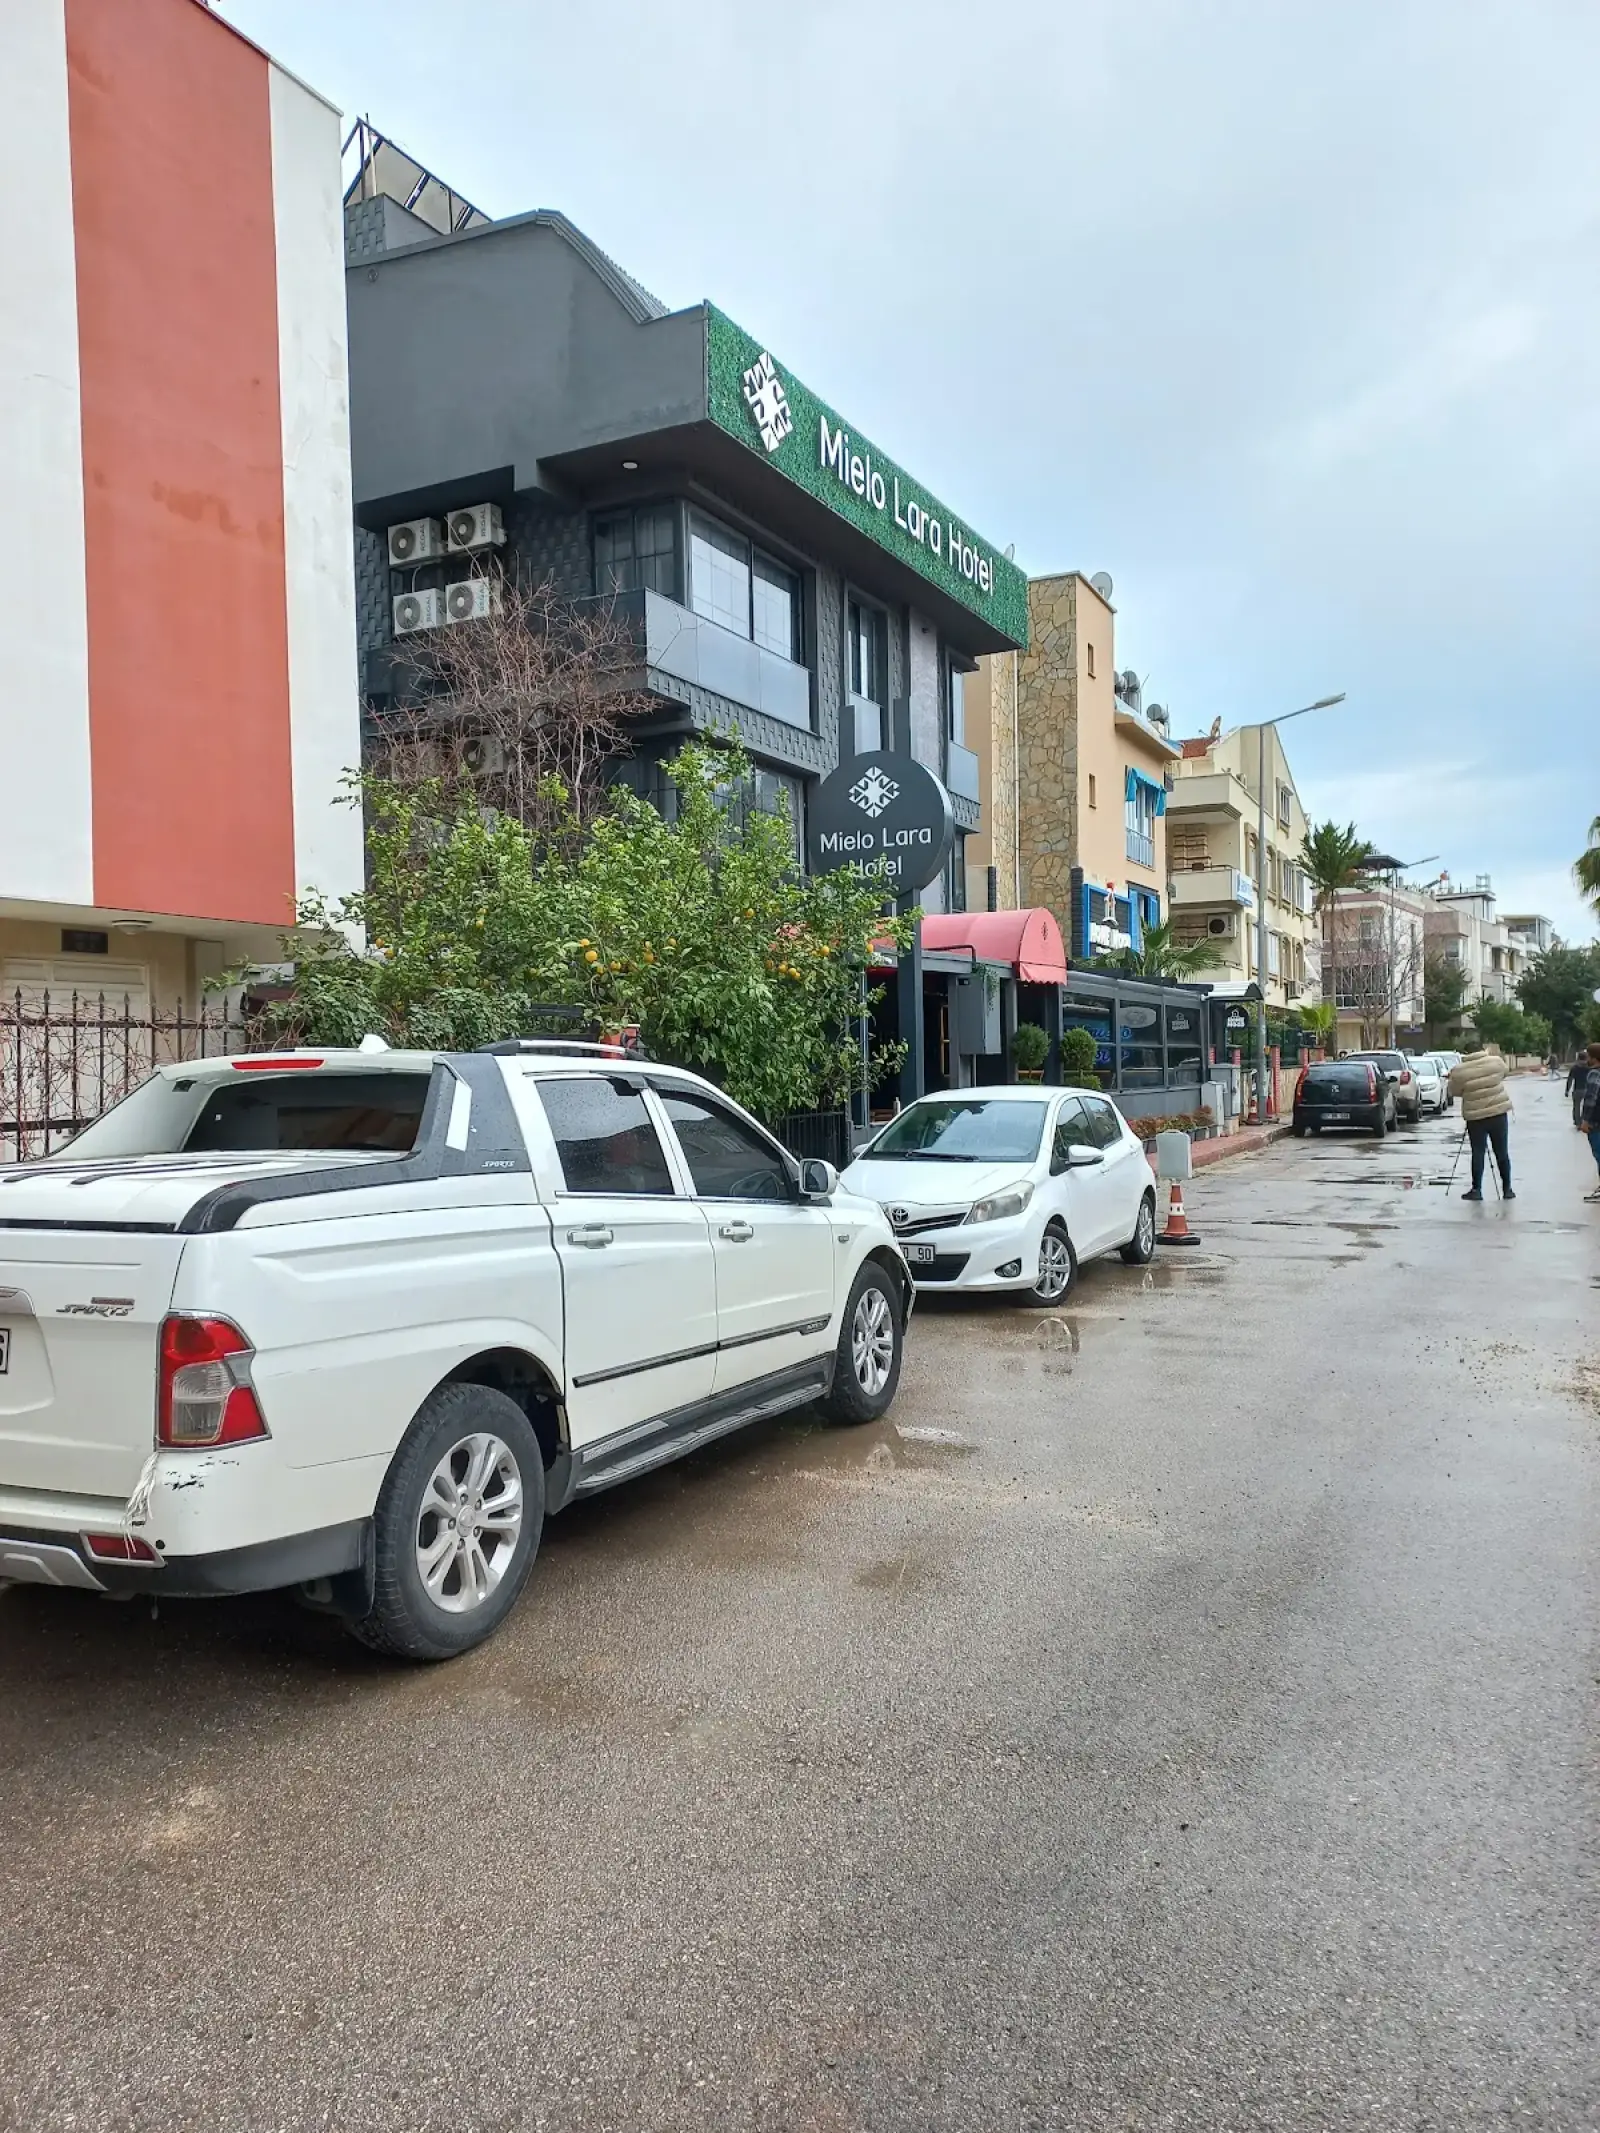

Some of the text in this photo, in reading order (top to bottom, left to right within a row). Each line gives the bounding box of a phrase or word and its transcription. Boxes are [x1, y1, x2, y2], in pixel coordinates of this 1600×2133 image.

[819, 415, 994, 597] Mielo Lara Hotel
[820, 827, 932, 853] Mielo Lara
[481, 1160, 515, 1168] SPORTS
[918, 1247, 932, 1260] 90
[56, 1304, 134, 1317] SPORTS
